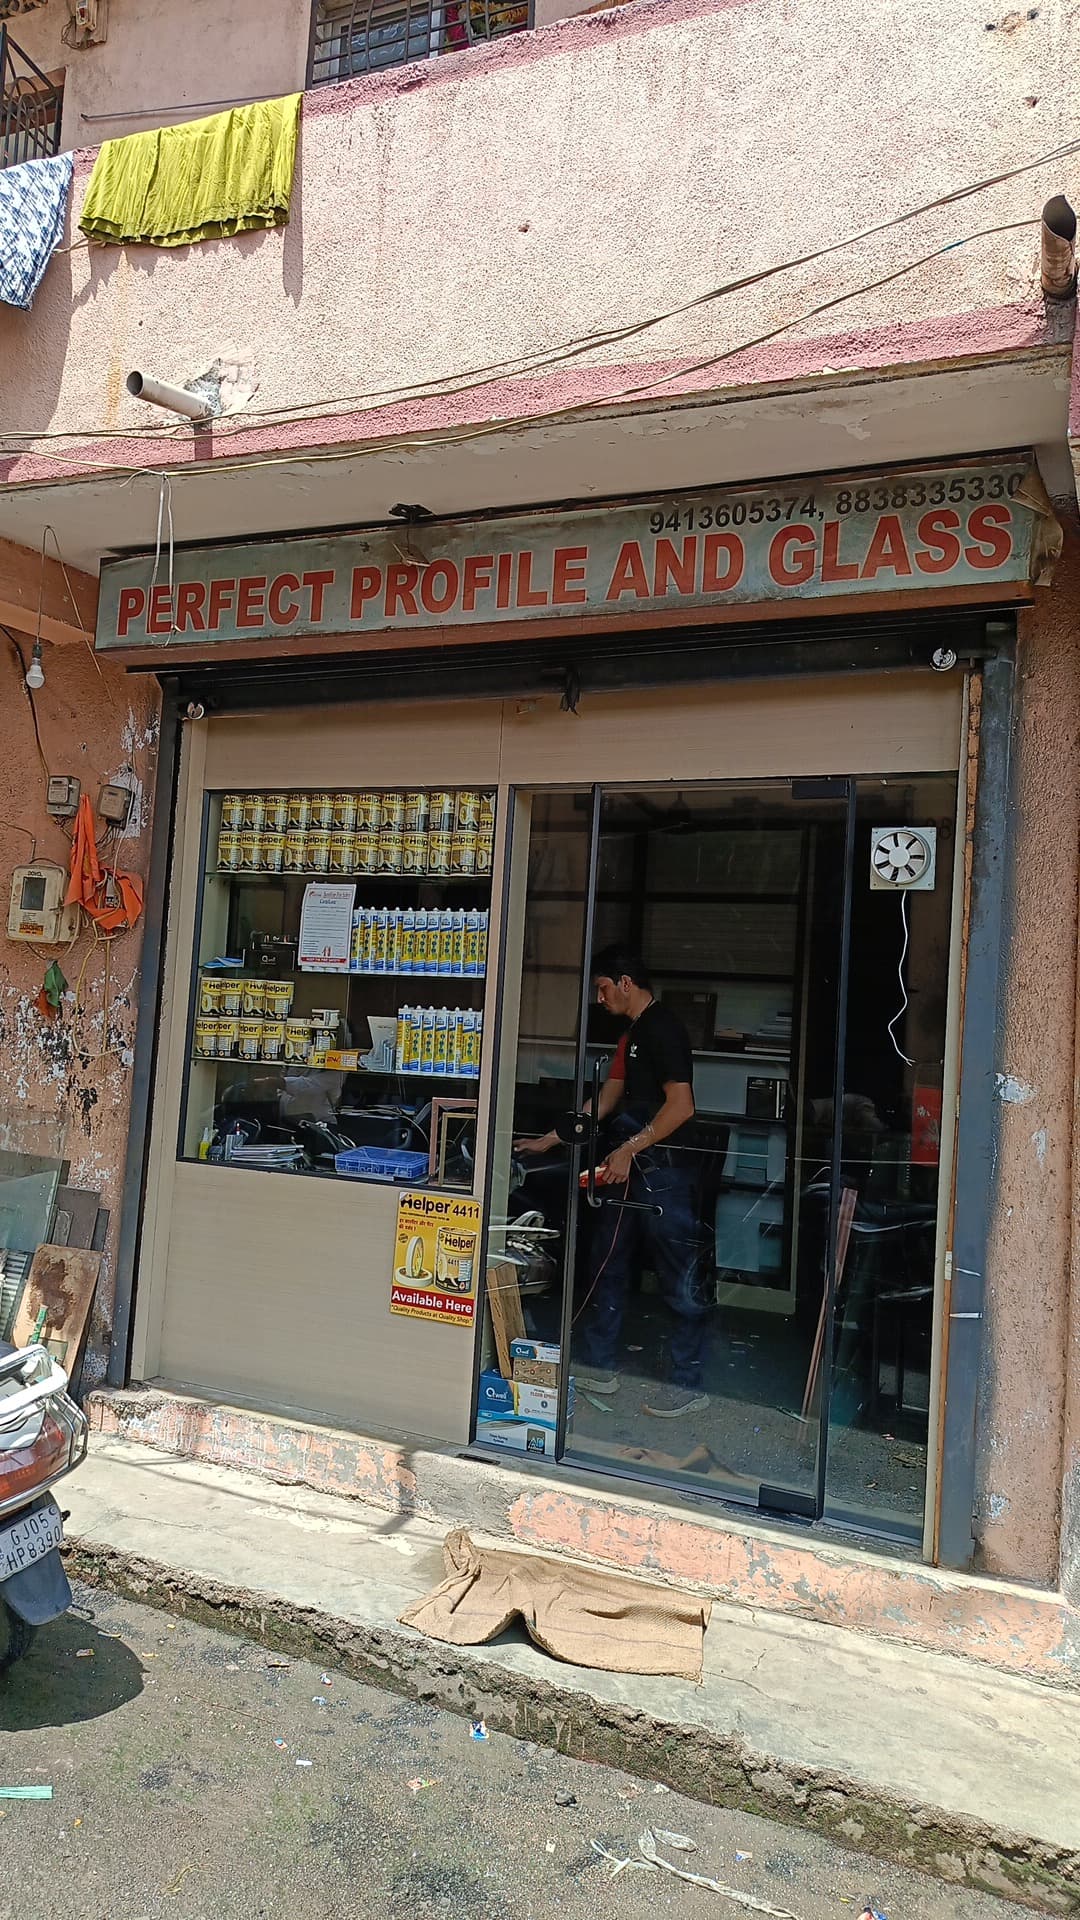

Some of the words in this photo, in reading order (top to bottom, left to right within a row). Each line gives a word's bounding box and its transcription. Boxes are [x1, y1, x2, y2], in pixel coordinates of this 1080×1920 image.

[649, 496, 824, 534] 9413605374,
[116, 567, 336, 637] PERFECT
[350, 545, 588, 620] PROFILE
[605, 531, 744, 601] AND
[767, 503, 1014, 588] GLASS
[400, 1194, 451, 1215] Helper
[453, 1204, 480, 1219] 4411
[445, 1233, 473, 1249] Helper
[391, 1289, 443, 1309] Available
[445, 1299, 473, 1313] Here
[410, 1308, 432, 1317] Products
[439, 1313, 456, 1322] Quality
[10, 1512, 49, 1546] GJ05
[7, 1525, 61, 1571] HP8390
